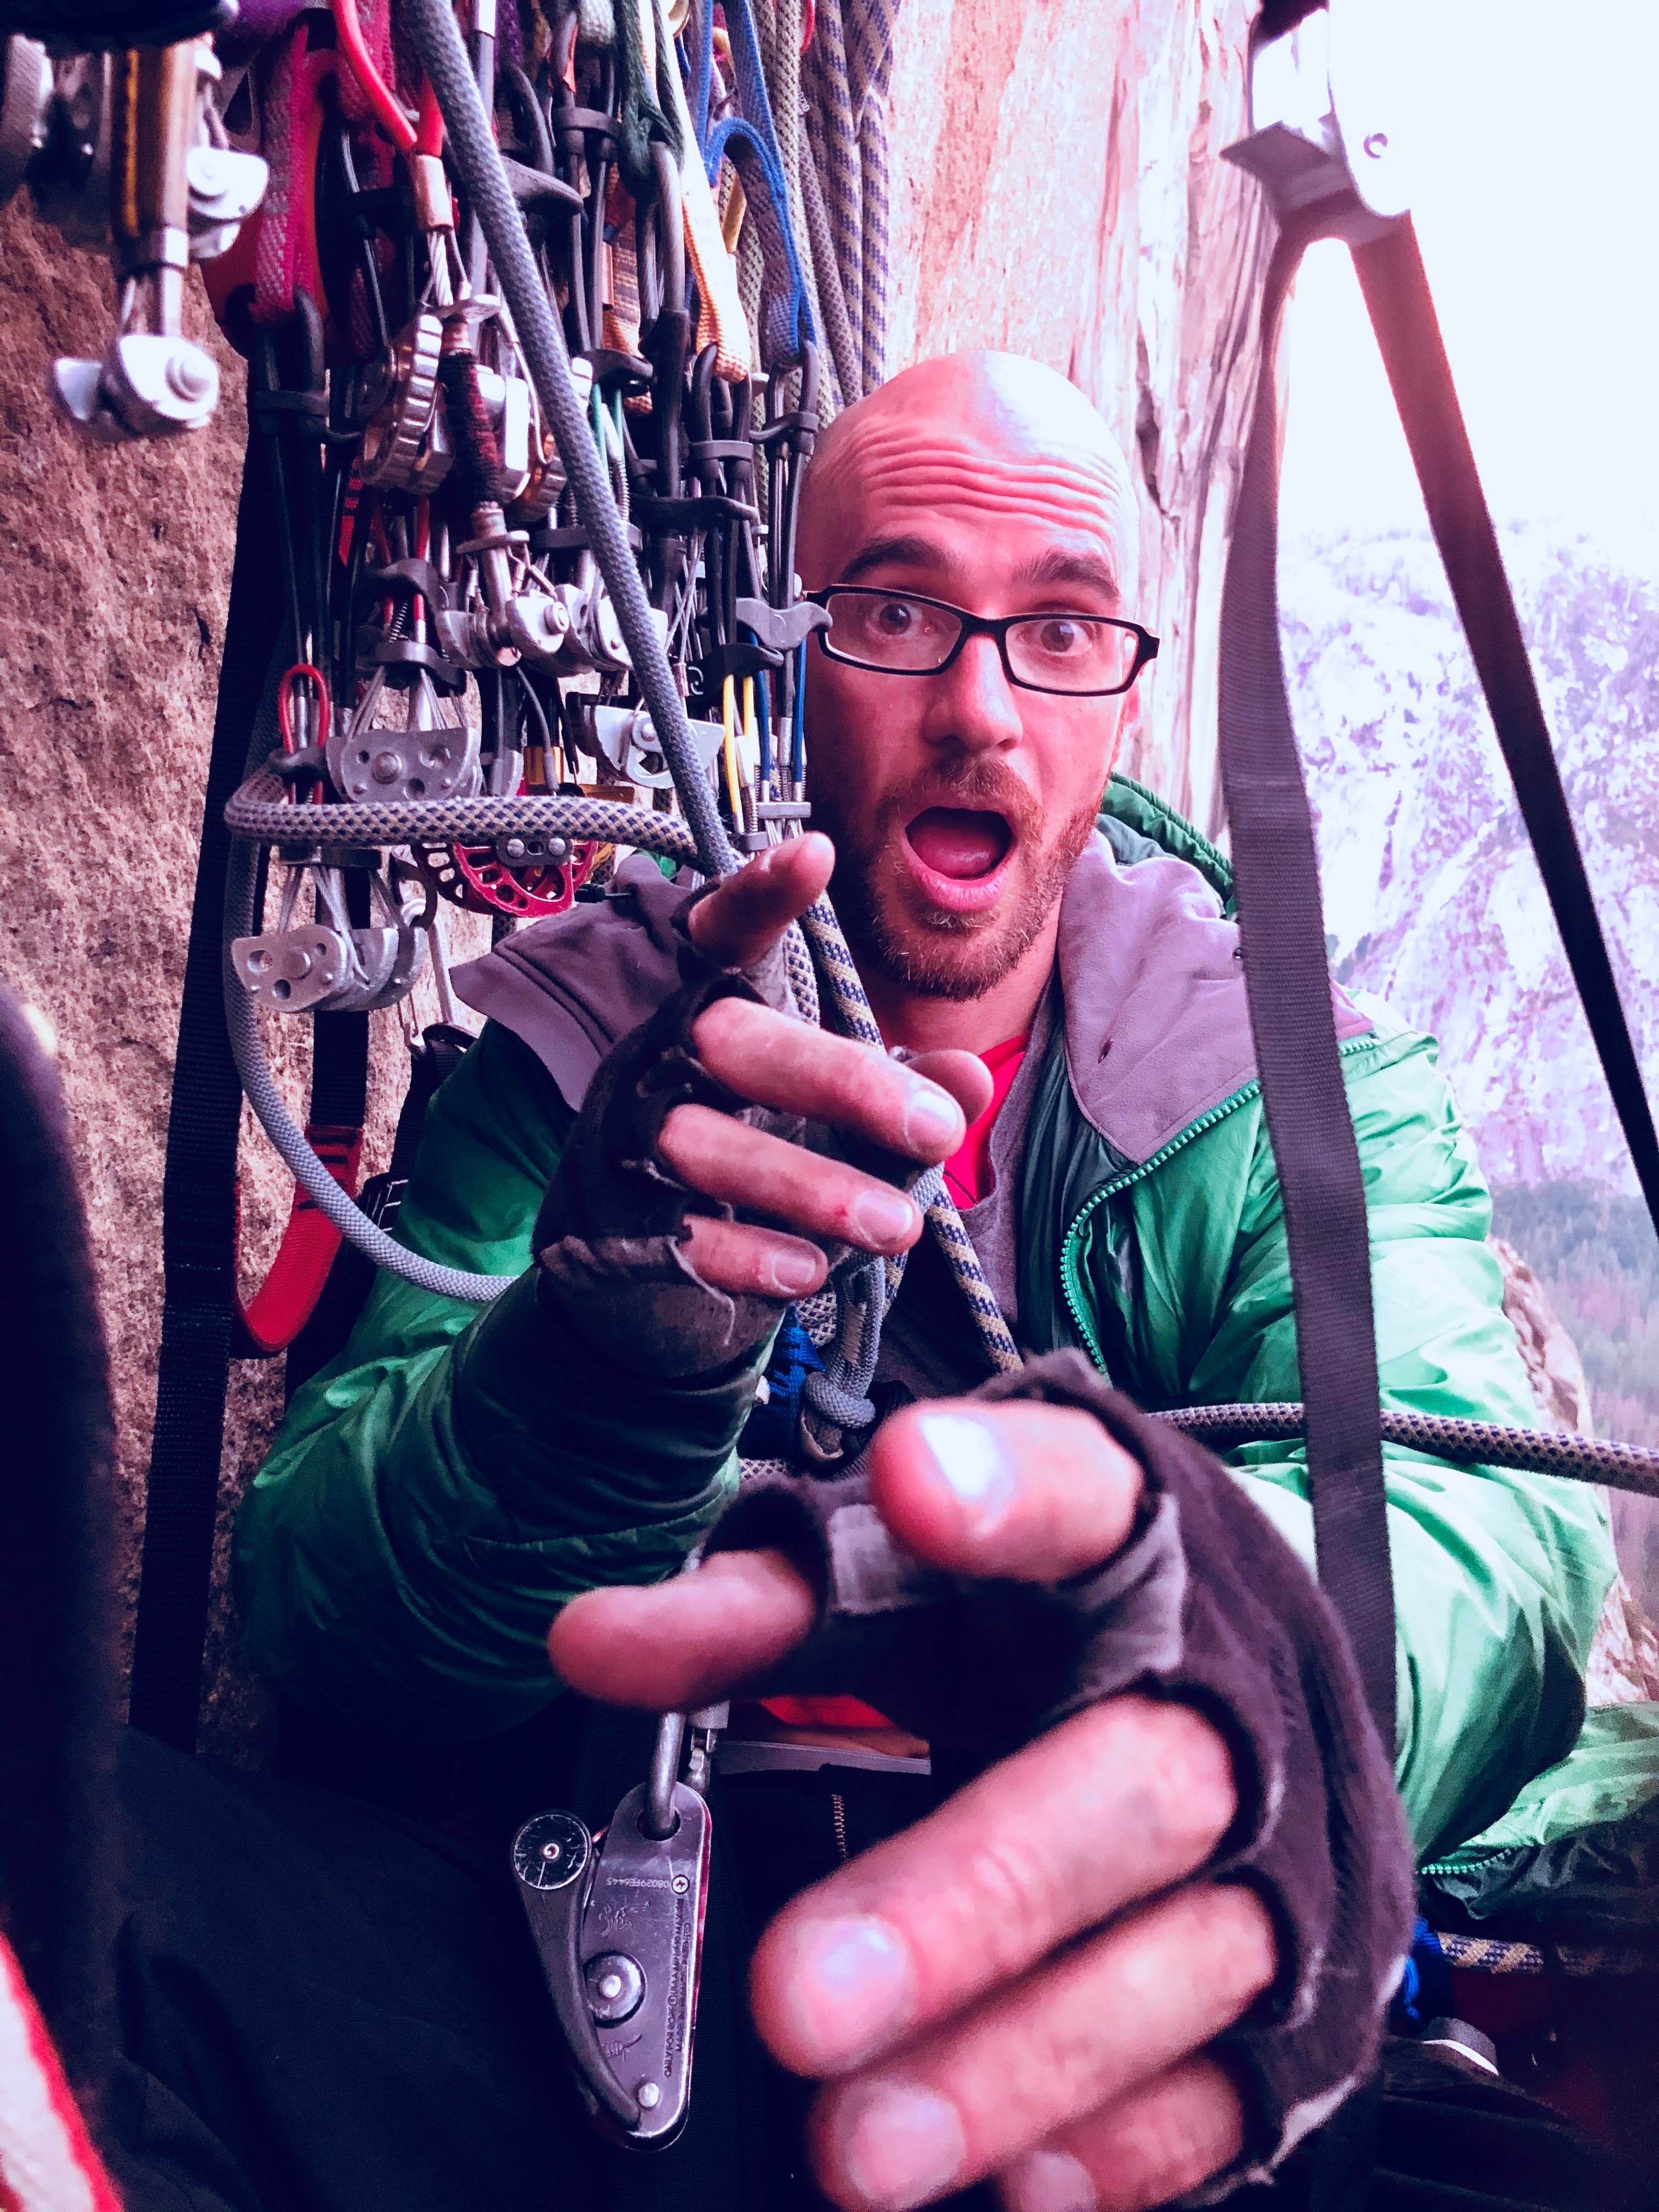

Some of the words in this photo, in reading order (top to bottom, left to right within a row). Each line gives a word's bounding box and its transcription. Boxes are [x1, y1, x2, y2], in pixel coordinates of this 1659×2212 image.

[667, 2006, 676, 2030] ROPE
[677, 2011, 685, 2020] IN
[665, 2031, 674, 2051] FOR
[674, 2022, 684, 2052] MADE
[664, 2051, 673, 2079] ONLY
